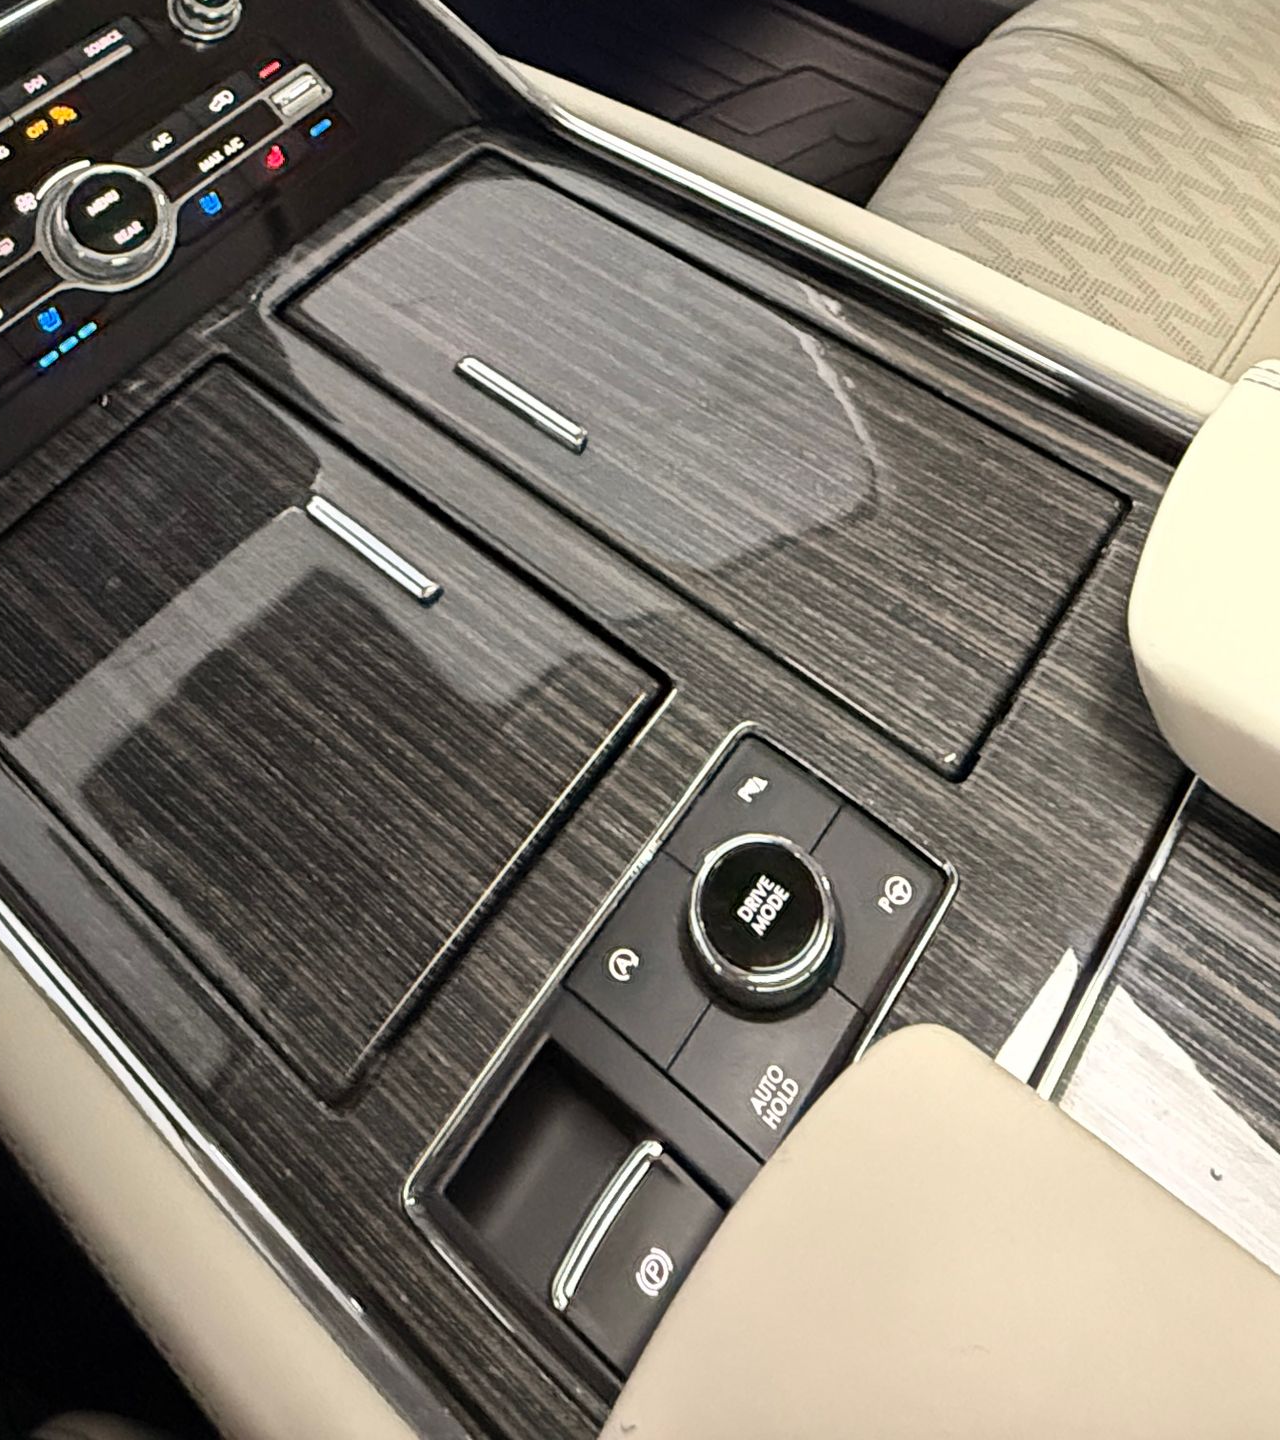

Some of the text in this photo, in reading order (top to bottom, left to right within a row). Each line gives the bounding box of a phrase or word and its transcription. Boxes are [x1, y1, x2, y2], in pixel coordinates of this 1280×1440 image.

[737, 875, 775, 923] DRIVE
[751, 885, 791, 937] MODE
[750, 1065, 784, 1116] AUTO
[762, 1078, 799, 1130] HOLD
